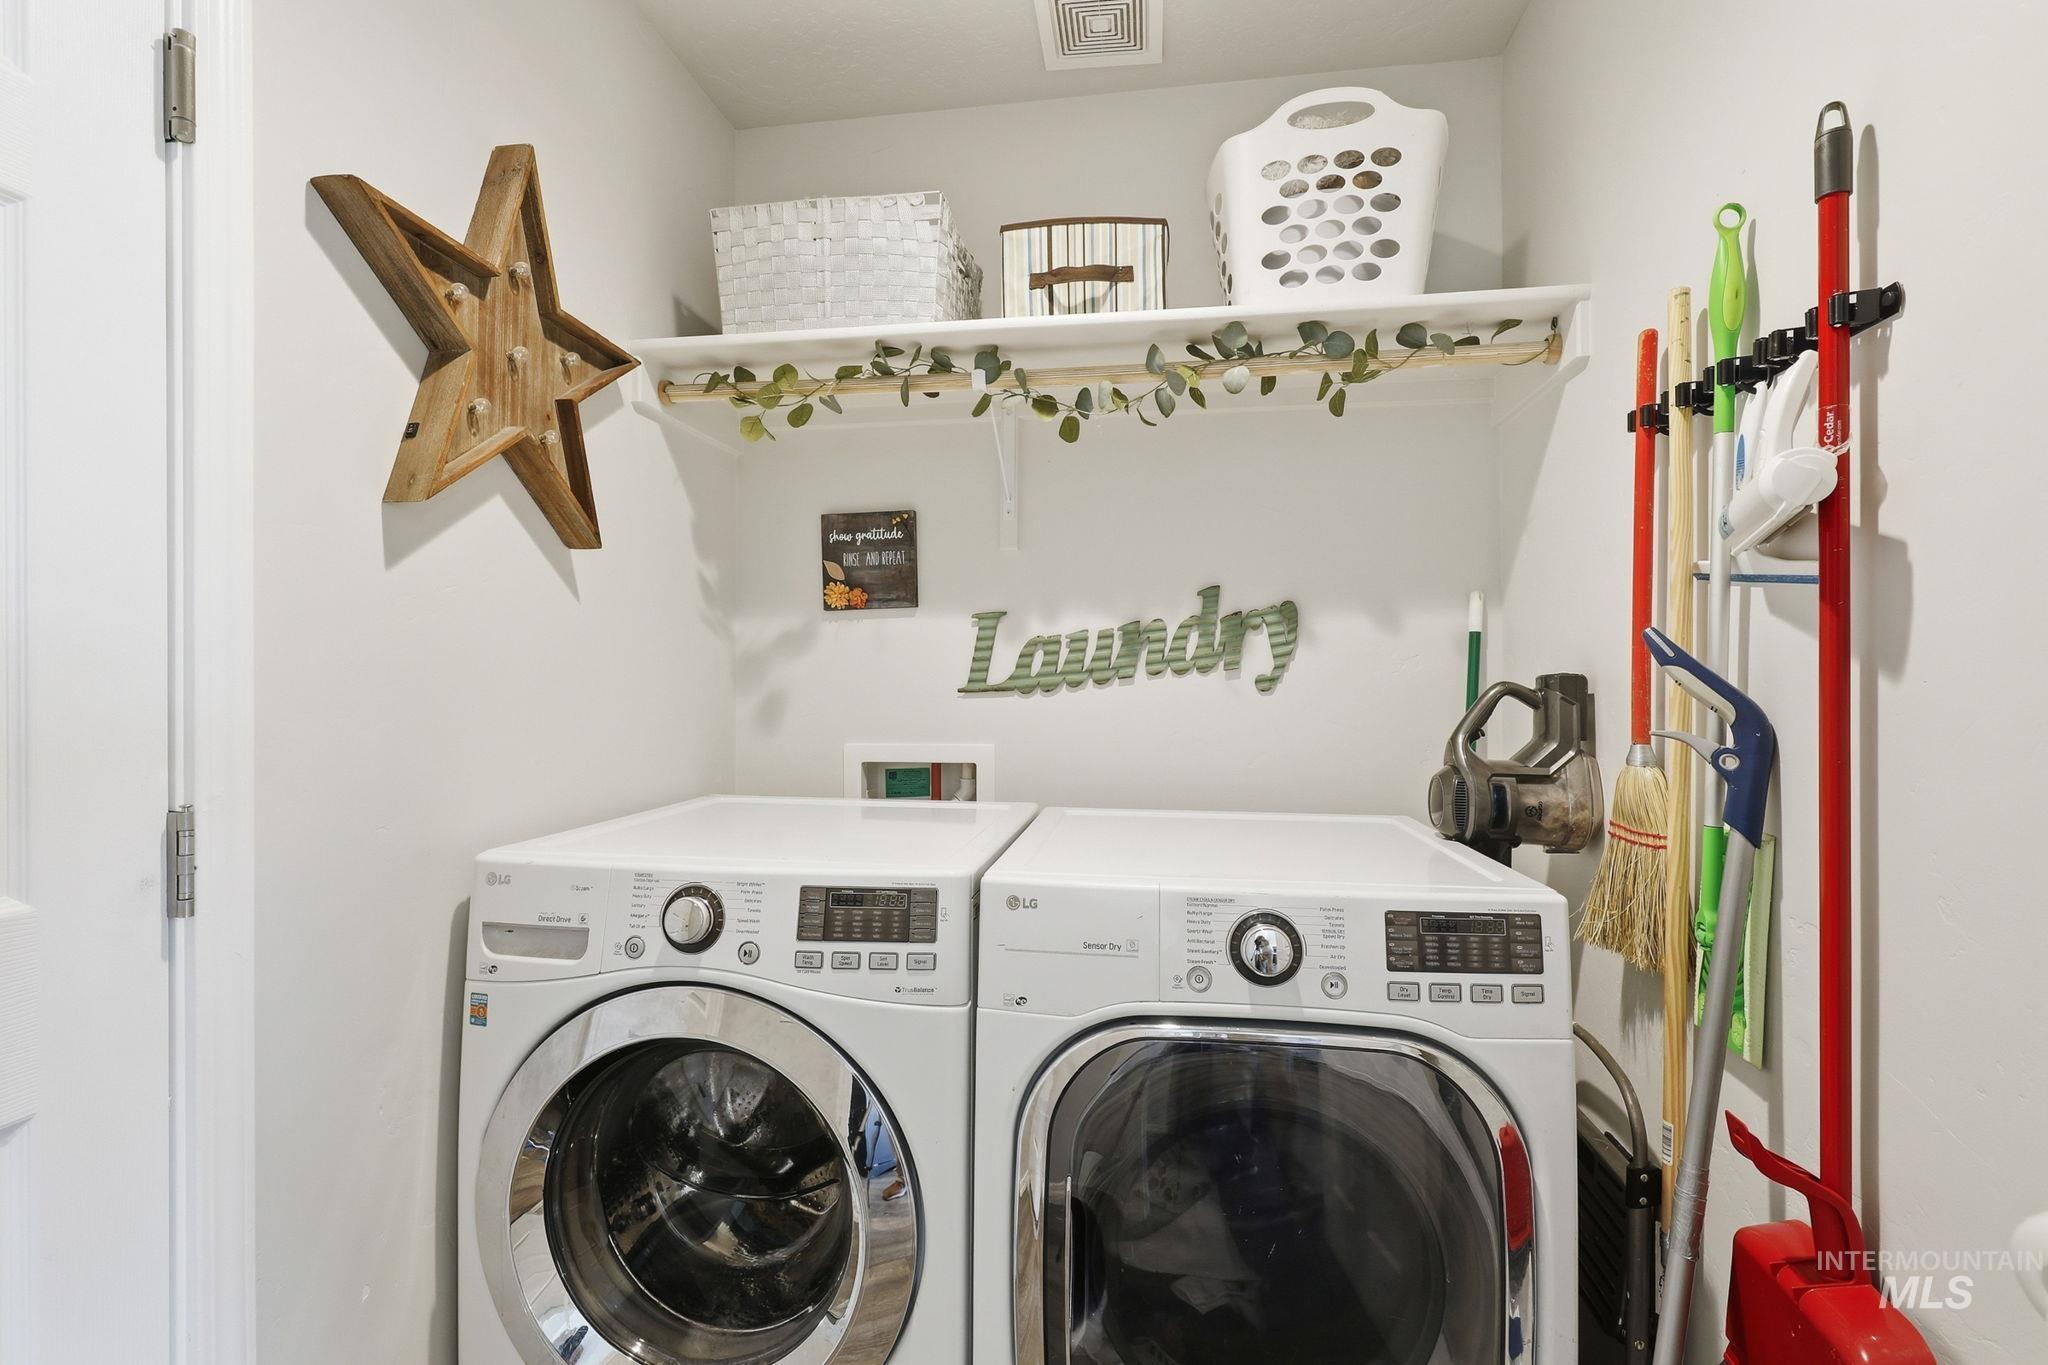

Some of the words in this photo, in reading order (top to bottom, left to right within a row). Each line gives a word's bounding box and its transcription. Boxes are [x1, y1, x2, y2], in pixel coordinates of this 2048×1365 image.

[829, 529, 853, 543] show
[855, 527, 904, 545] gratitude
[842, 552, 860, 567] RINSE
[865, 551, 880, 566] AND
[881, 550, 905, 565] REPEAT
[957, 585, 1298, 693] Laundry
[498, 873, 512, 885] LG
[1022, 898, 1038, 909] LG
[538, 914, 556, 923] Direct
[556, 915, 571, 923] Drive
[1083, 941, 1107, 950] Sensor
[1109, 942, 1121, 952] Dry
